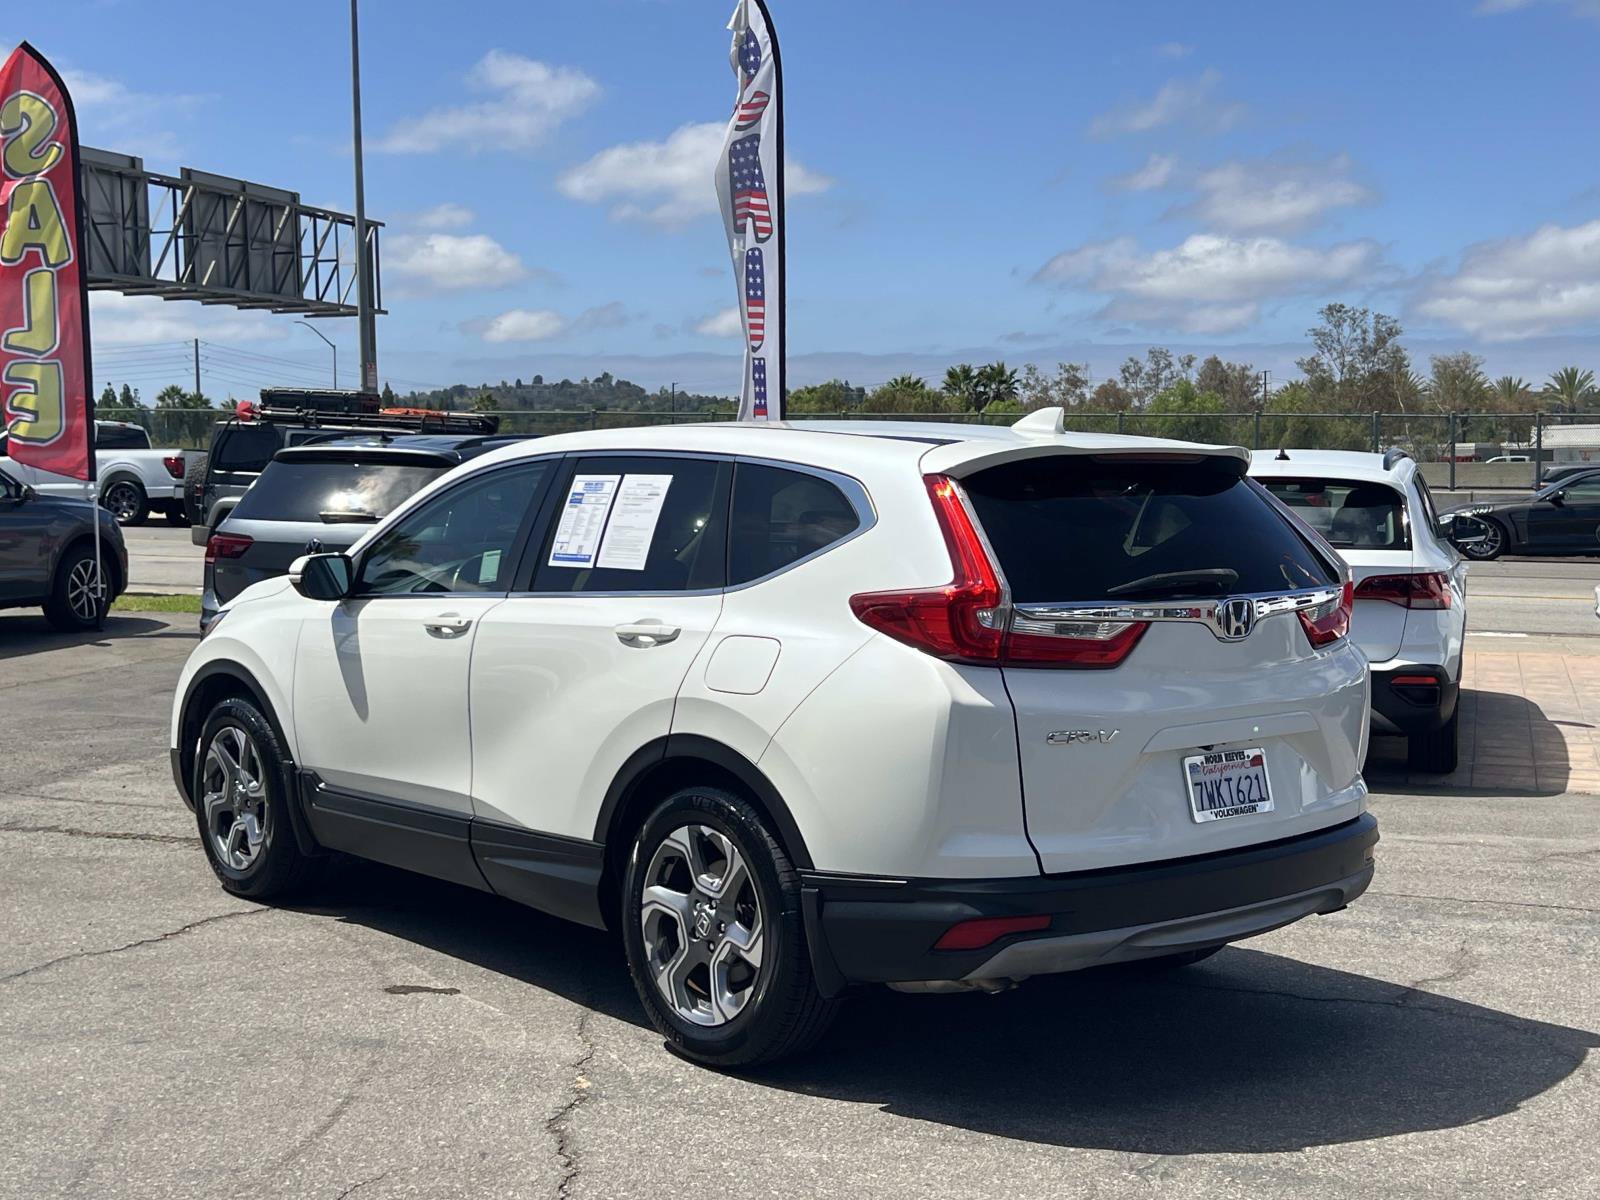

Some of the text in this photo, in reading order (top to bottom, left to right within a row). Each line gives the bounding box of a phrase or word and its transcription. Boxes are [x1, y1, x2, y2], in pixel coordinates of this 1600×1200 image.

[1046, 729, 1120, 745] CR-V
[1204, 753, 1223, 765] NORM
[1224, 751, 1245, 763] REEVES
[1202, 761, 1251, 775] California
[1194, 773, 1267, 811] 7WKT621
